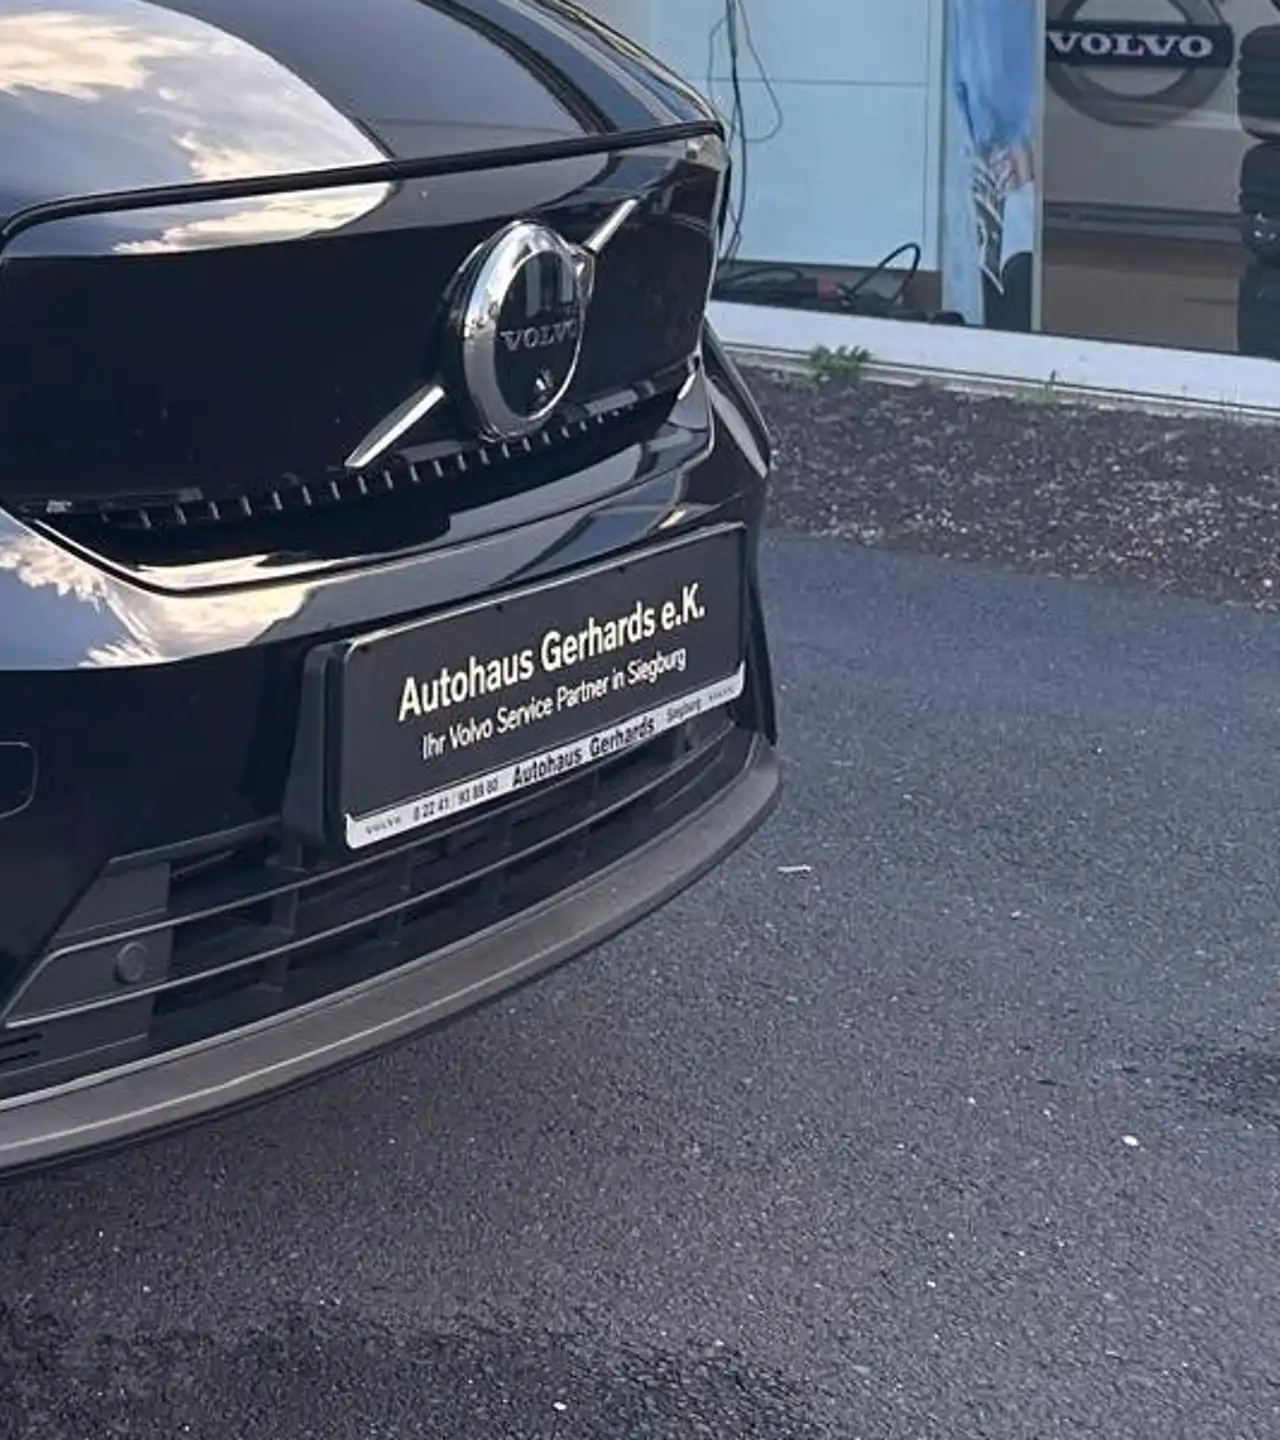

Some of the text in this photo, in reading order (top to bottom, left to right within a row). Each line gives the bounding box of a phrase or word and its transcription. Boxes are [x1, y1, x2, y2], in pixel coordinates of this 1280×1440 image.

[1046, 30, 1214, 59] VOLVO
[397, 581, 707, 722] Autohaus Gerhards e.K.
[422, 645, 687, 761] Ihr Volvo Service Partner in Siegburg
[512, 747, 582, 788] Autohaus
[589, 716, 656, 758] Gerhards
